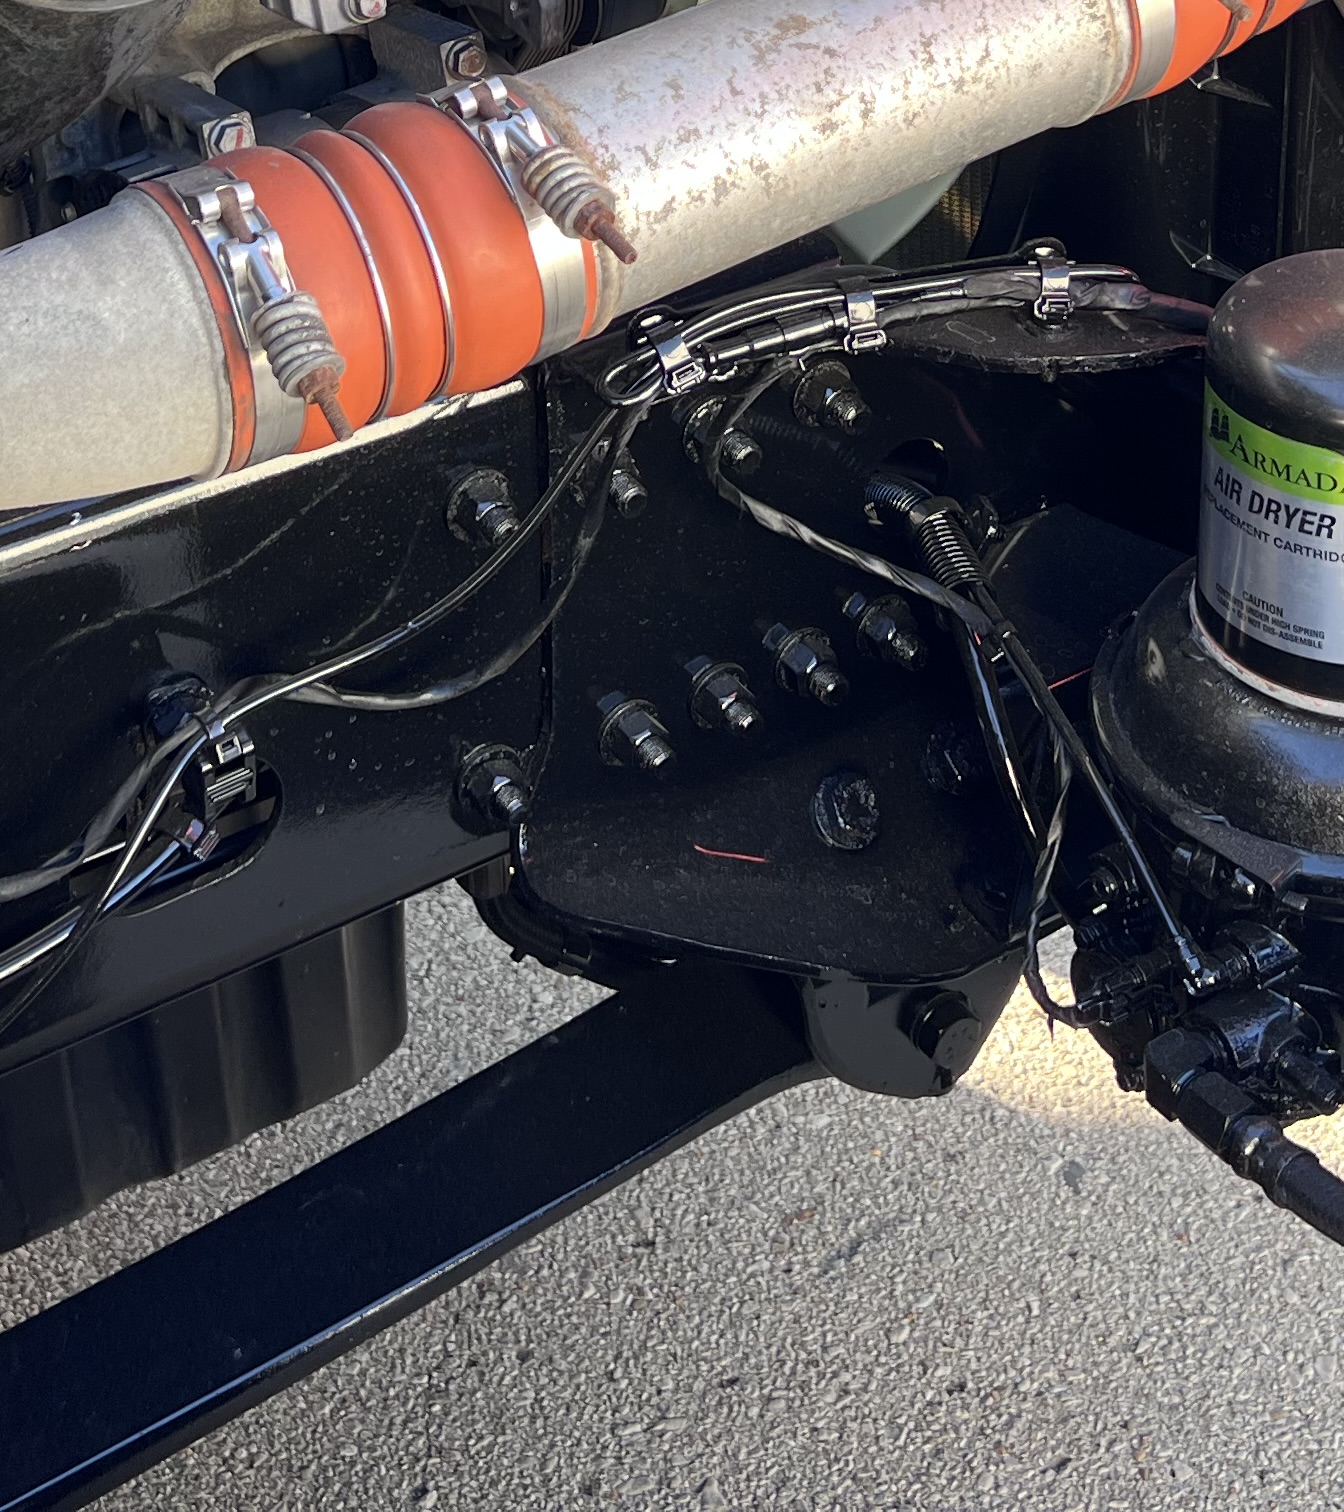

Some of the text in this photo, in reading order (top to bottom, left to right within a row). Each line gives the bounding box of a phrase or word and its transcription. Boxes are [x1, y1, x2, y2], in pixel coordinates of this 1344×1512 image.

[1213, 466, 1337, 540] AIR DRYER
[1242, 590, 1284, 617] CAUTION
[1247, 616, 1261, 630] NOT
[1262, 623, 1324, 650] DIS-ASSEMBLE
[1271, 615, 1291, 631] HIGH
[1292, 624, 1325, 640] SPRING
